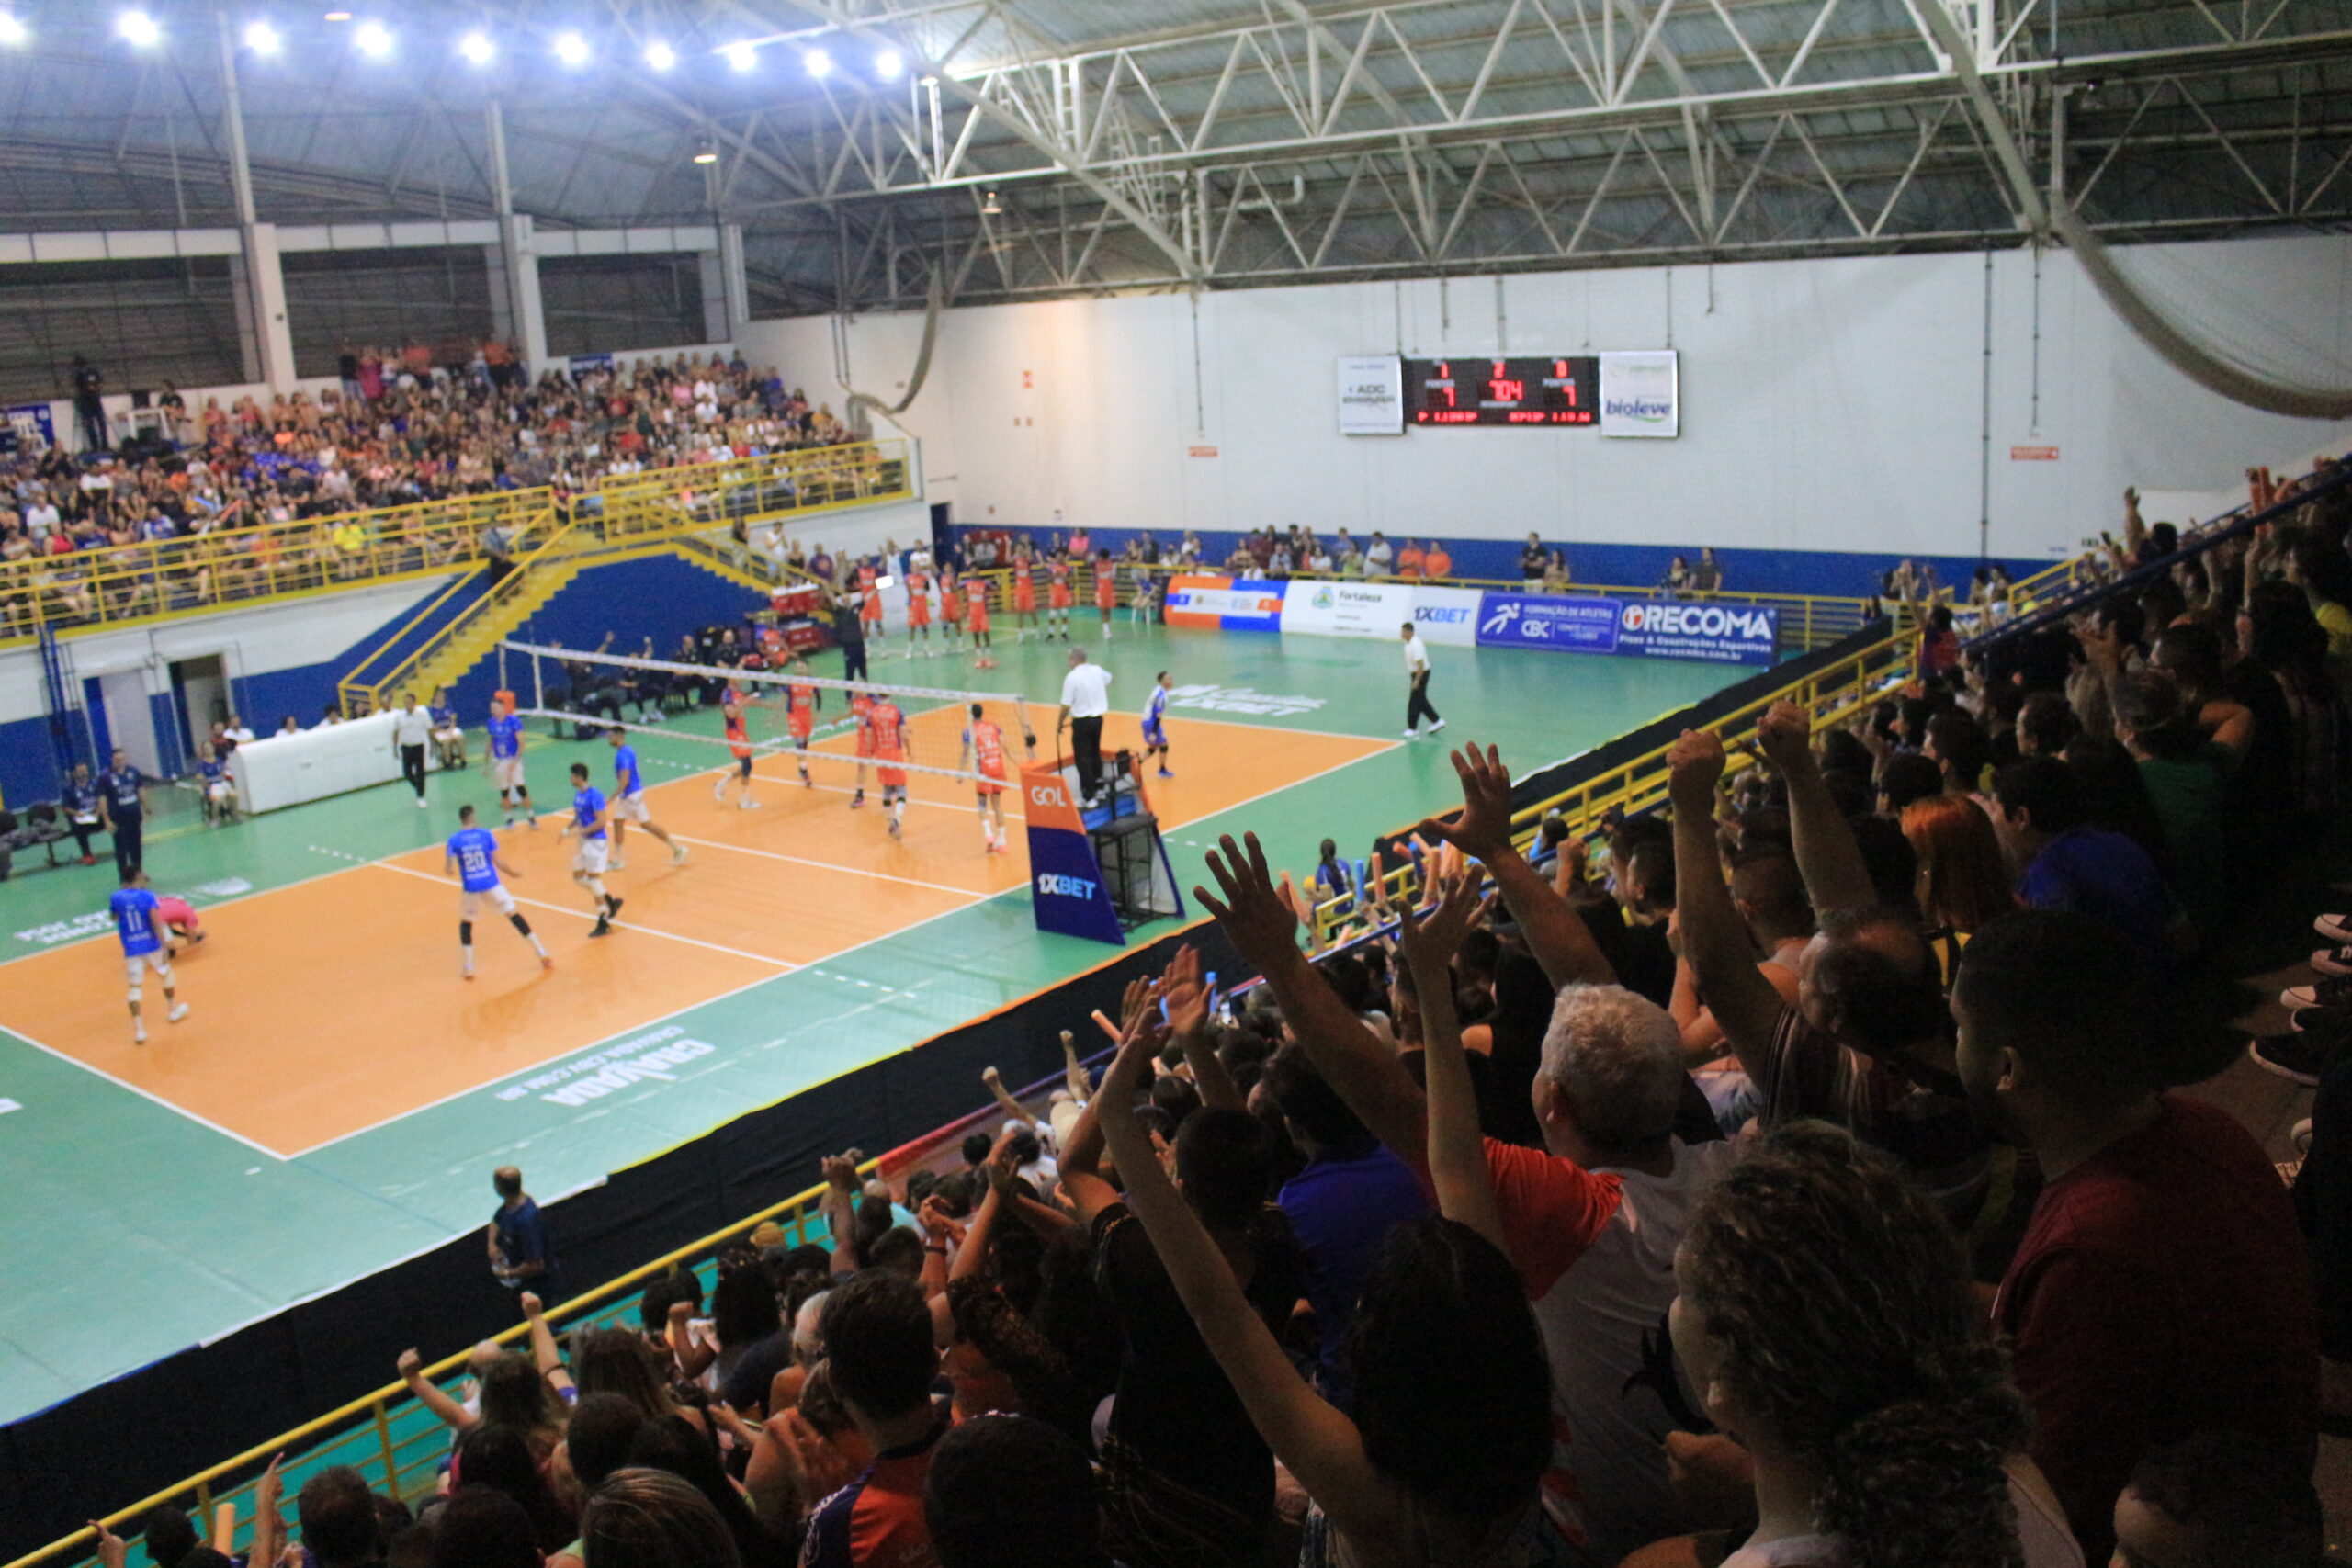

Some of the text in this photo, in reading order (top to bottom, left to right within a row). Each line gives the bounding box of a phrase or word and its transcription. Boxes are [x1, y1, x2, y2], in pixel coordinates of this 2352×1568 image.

[1606, 399, 1671, 415] bioleve
[1340, 590, 1382, 603] Fortaleza
[1414, 607, 1470, 624] 1XBET
[1644, 604, 1772, 639] RECOMA
[1031, 785, 1067, 807] GOL
[462, 851, 487, 873] 20
[1038, 874, 1096, 900] 1XBET
